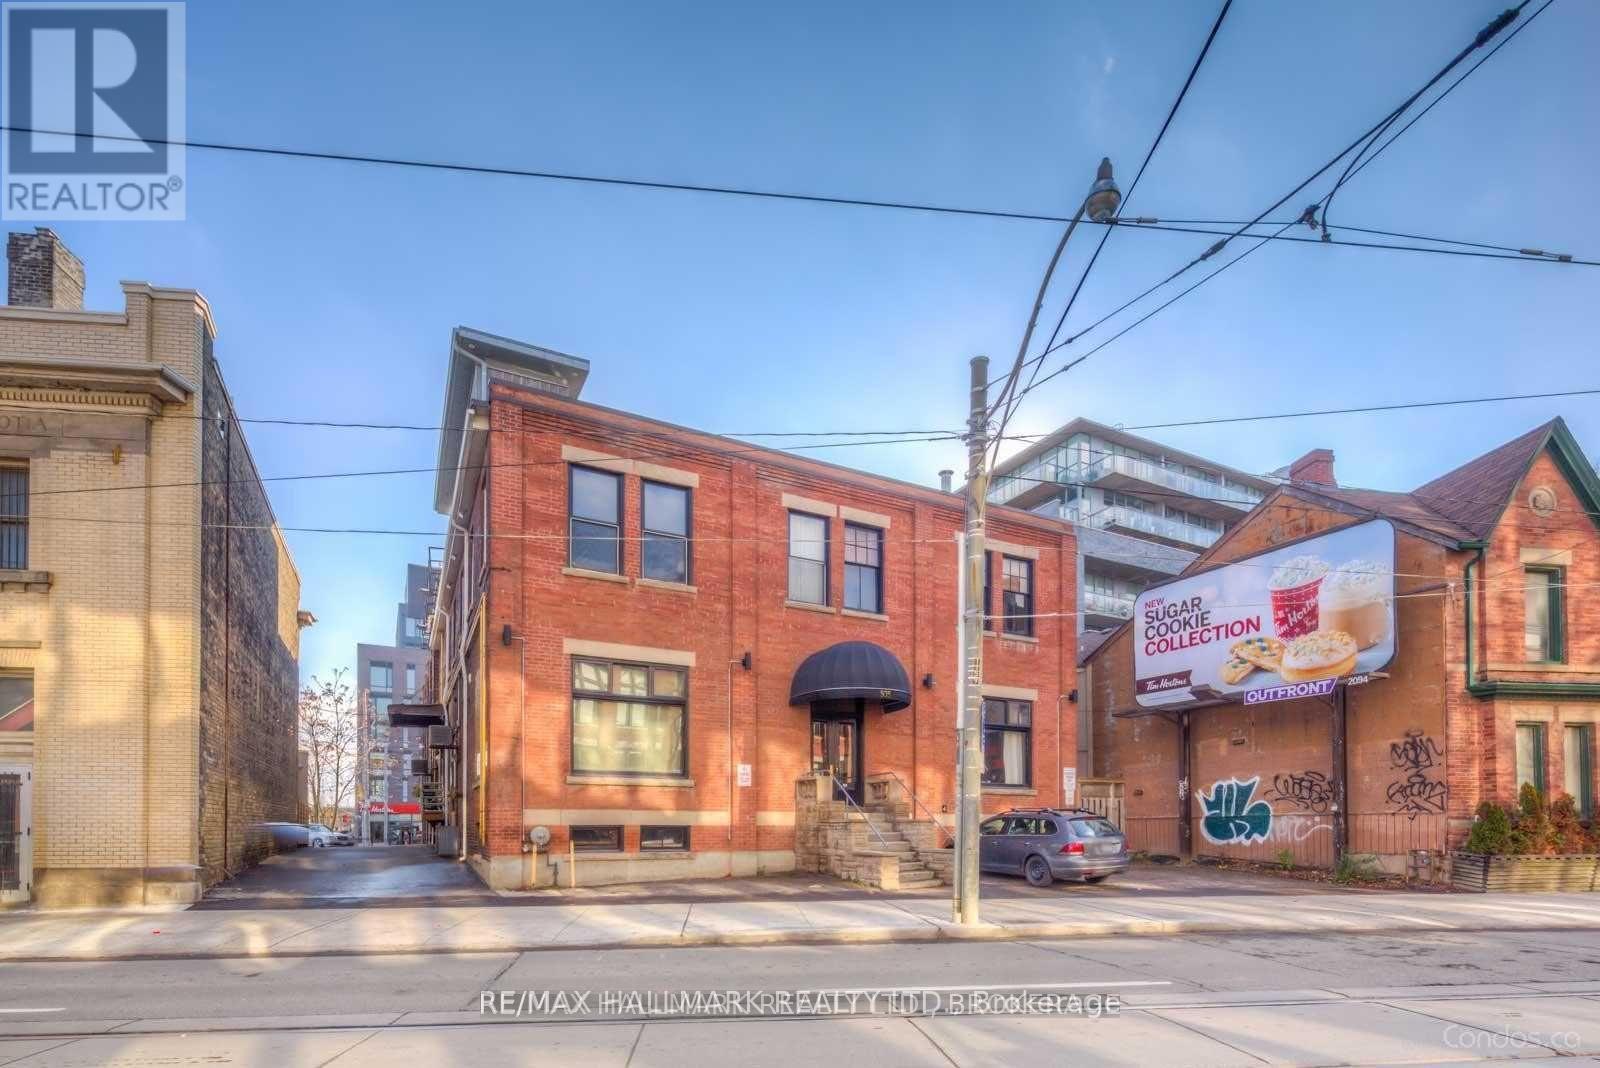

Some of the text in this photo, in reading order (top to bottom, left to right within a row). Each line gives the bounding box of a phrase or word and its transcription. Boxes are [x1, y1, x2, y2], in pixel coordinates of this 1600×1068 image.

[1144, 598, 1165, 609] NEW
[1145, 596, 1203, 625] SUGAR
[1145, 610, 1212, 641] COOKIE
[1145, 615, 1261, 657] COLLECTION
[1146, 677, 1188, 691] Tim Hortons
[1246, 679, 1332, 702] OUTFRONT
